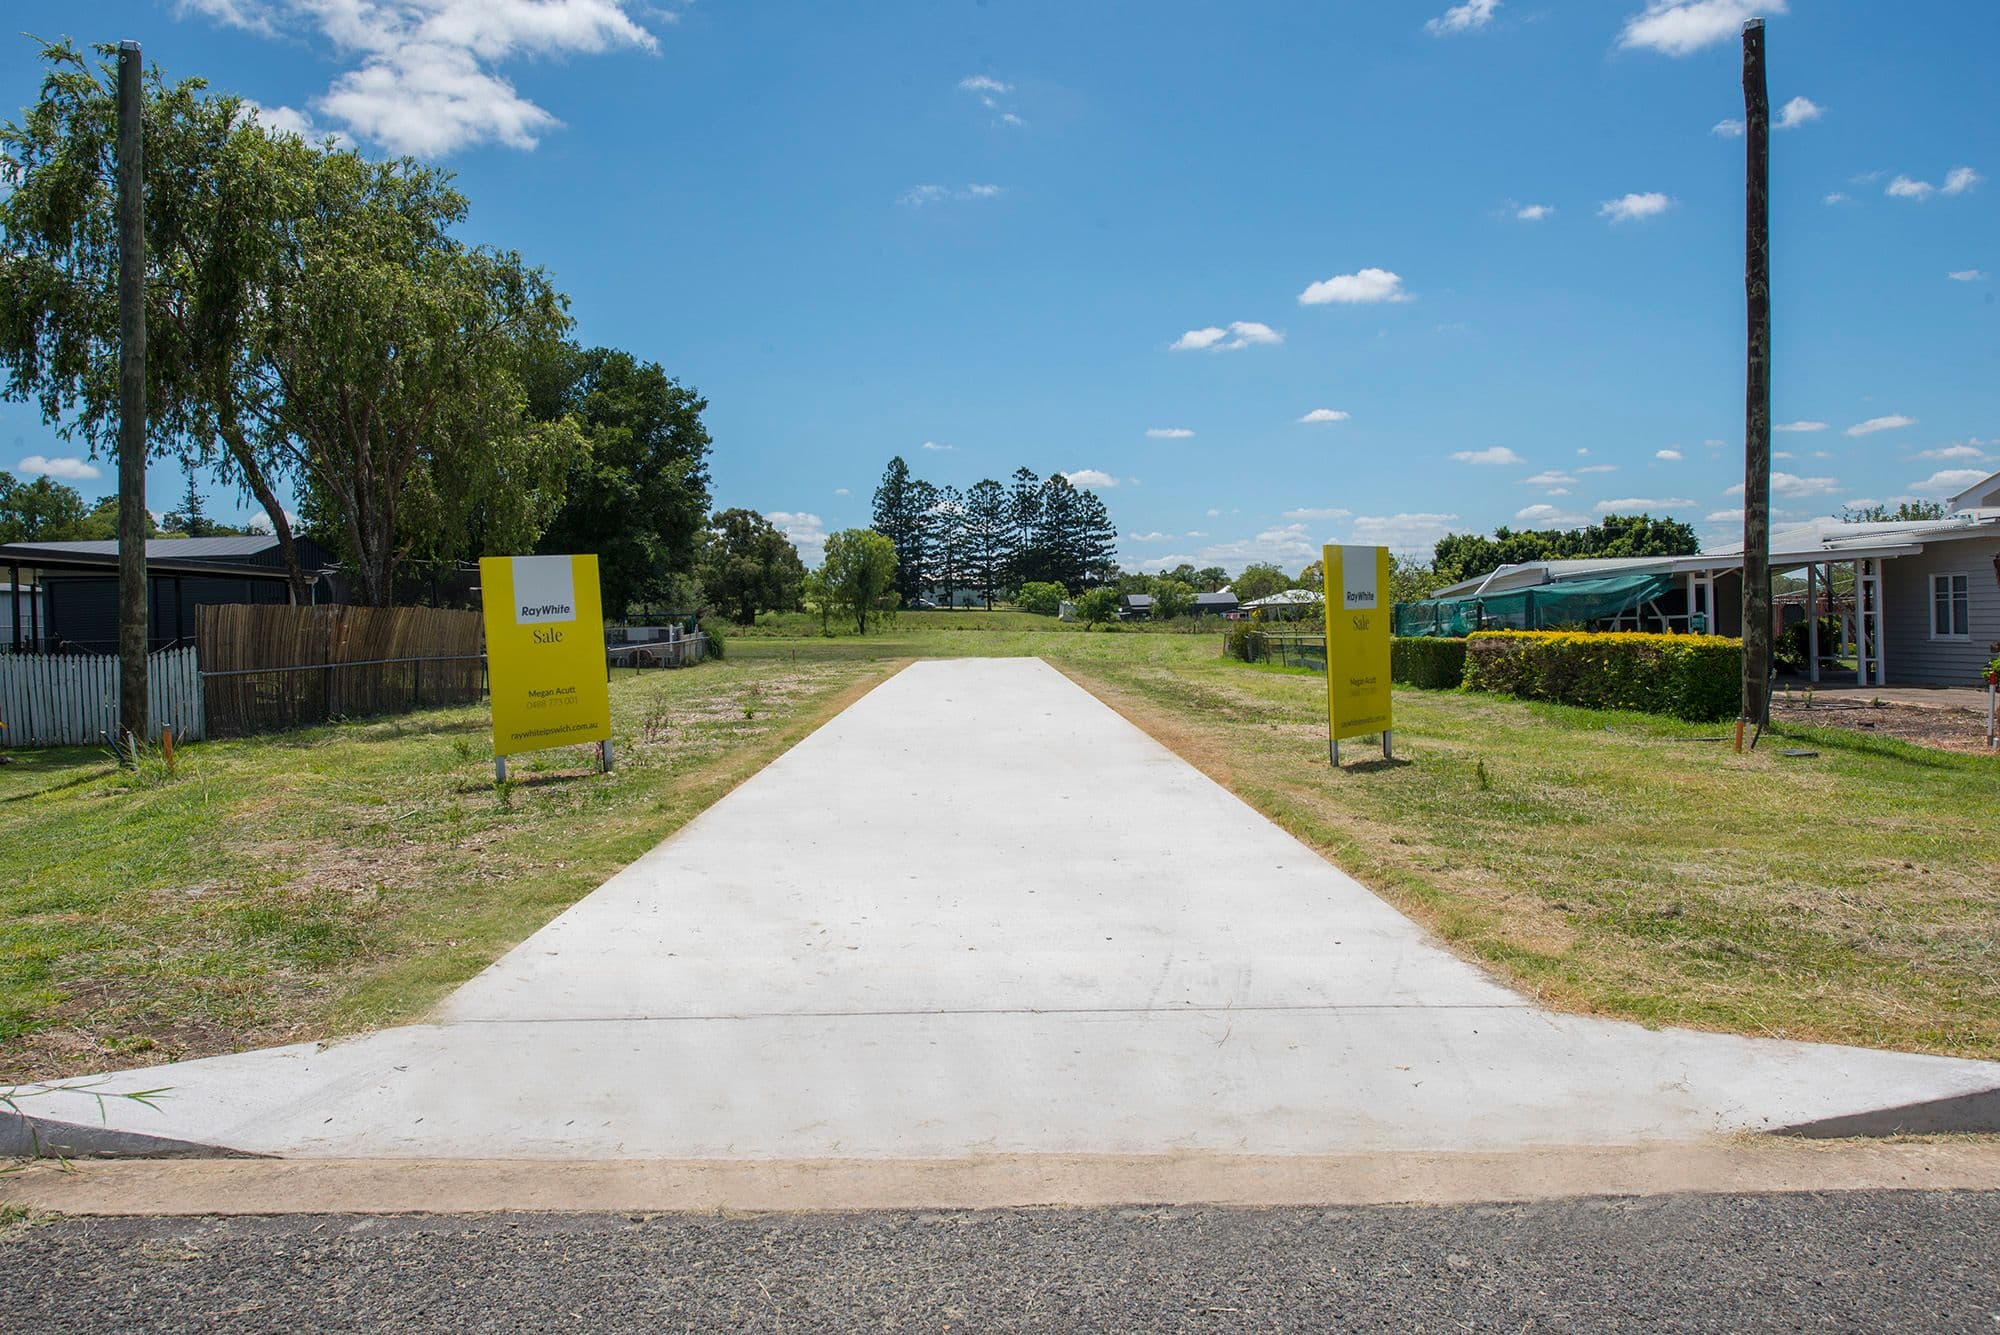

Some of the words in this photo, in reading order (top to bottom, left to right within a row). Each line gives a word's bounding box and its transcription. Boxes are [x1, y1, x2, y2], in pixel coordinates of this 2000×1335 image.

[1346, 591, 1374, 603] RayWhite
[521, 604, 570, 617] RayWhite
[1352, 613, 1370, 631] Sale
[533, 627, 563, 644] Sale
[528, 689, 554, 699] Megan
[555, 686, 577, 695] Acutt
[564, 695, 578, 705] 001
[511, 722, 599, 740] raywhiteipswich.com.au
